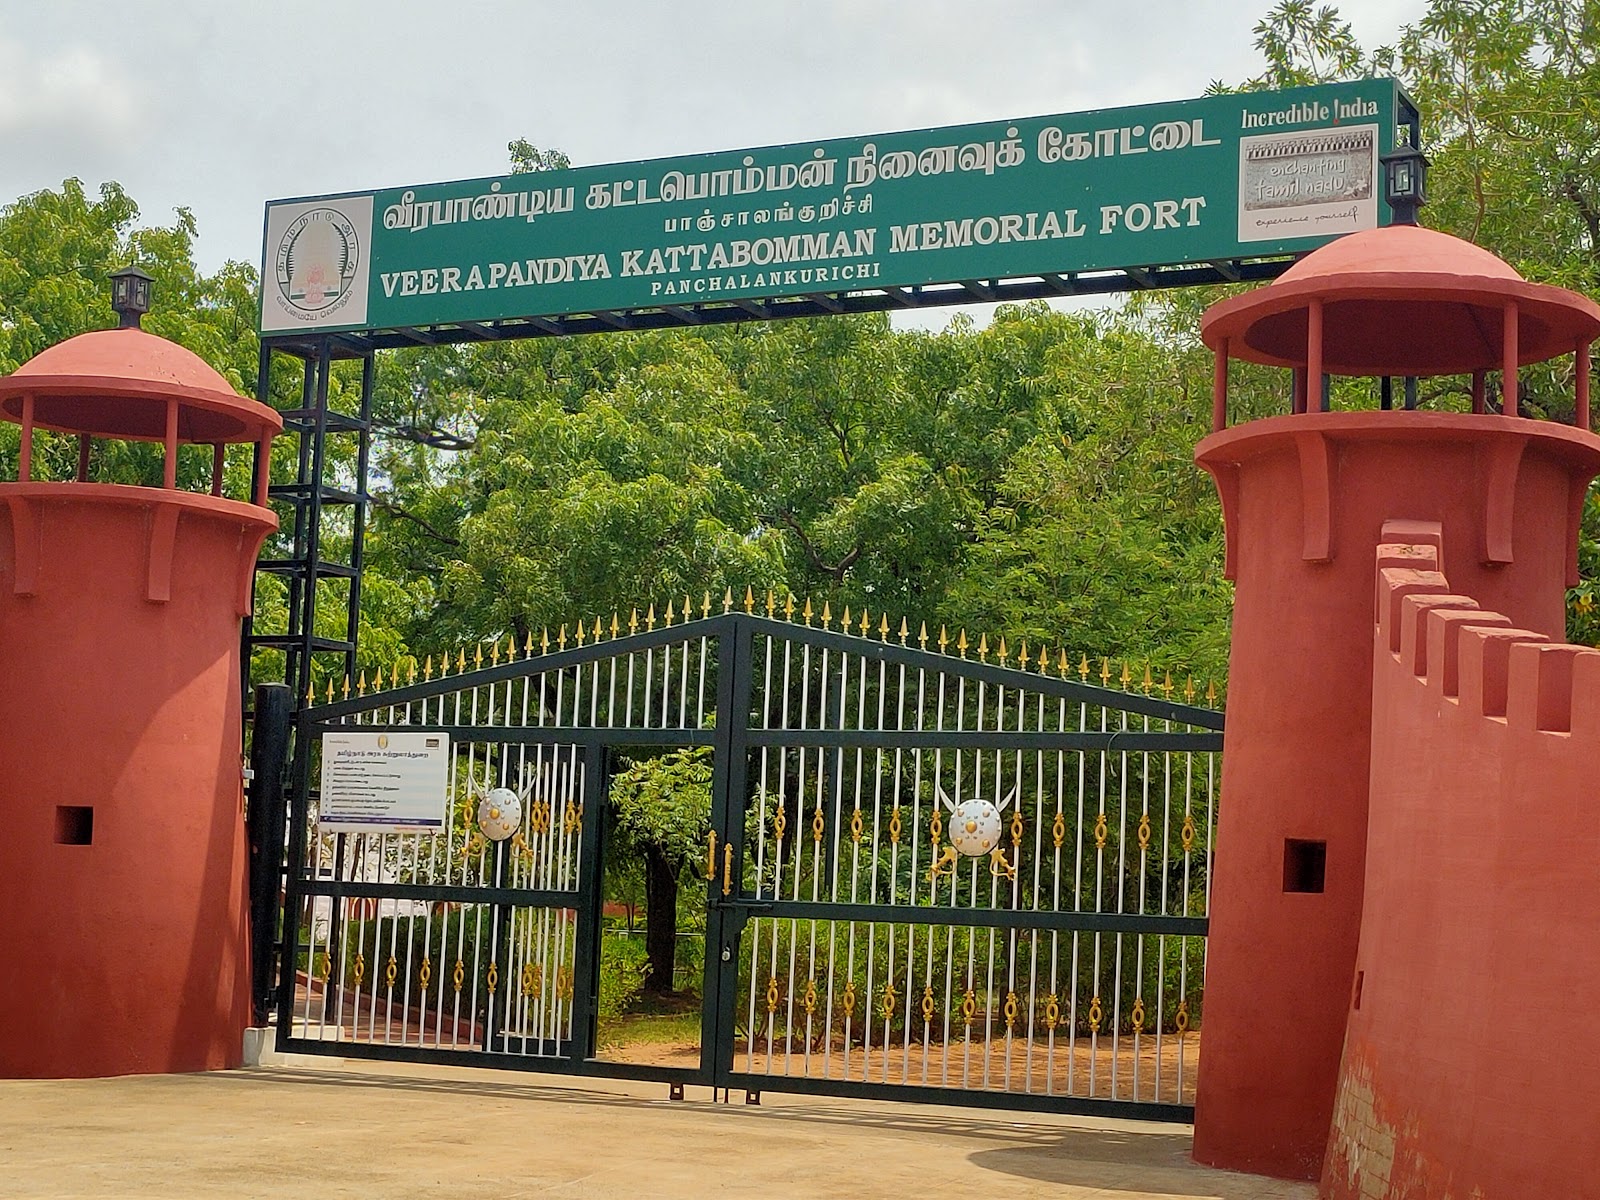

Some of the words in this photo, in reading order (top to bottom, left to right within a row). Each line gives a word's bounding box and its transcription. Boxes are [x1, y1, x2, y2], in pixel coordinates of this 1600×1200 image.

[1241, 101, 1329, 128] Incredible
[383, 181, 575, 233] வீரபாண்டிய
[585, 149, 838, 209] கட்டபொம்மன்
[843, 126, 1026, 194] நினைவுக்
[1037, 118, 1222, 164] கோட்டை
[1270, 157, 1347, 177] enchanting
[1255, 177, 1300, 199] tamil
[1305, 176, 1346, 194] nadu
[664, 193, 874, 232] பாஞ்சாலங்குறிச்சி
[380, 253, 612, 298] VEERAPANDIYA
[620, 228, 877, 278] KATTABOMMAN
[889, 209, 1087, 253] MEMORIAL
[1099, 196, 1207, 235] FORT
[650, 262, 881, 296] PANCHALANKURICHI
